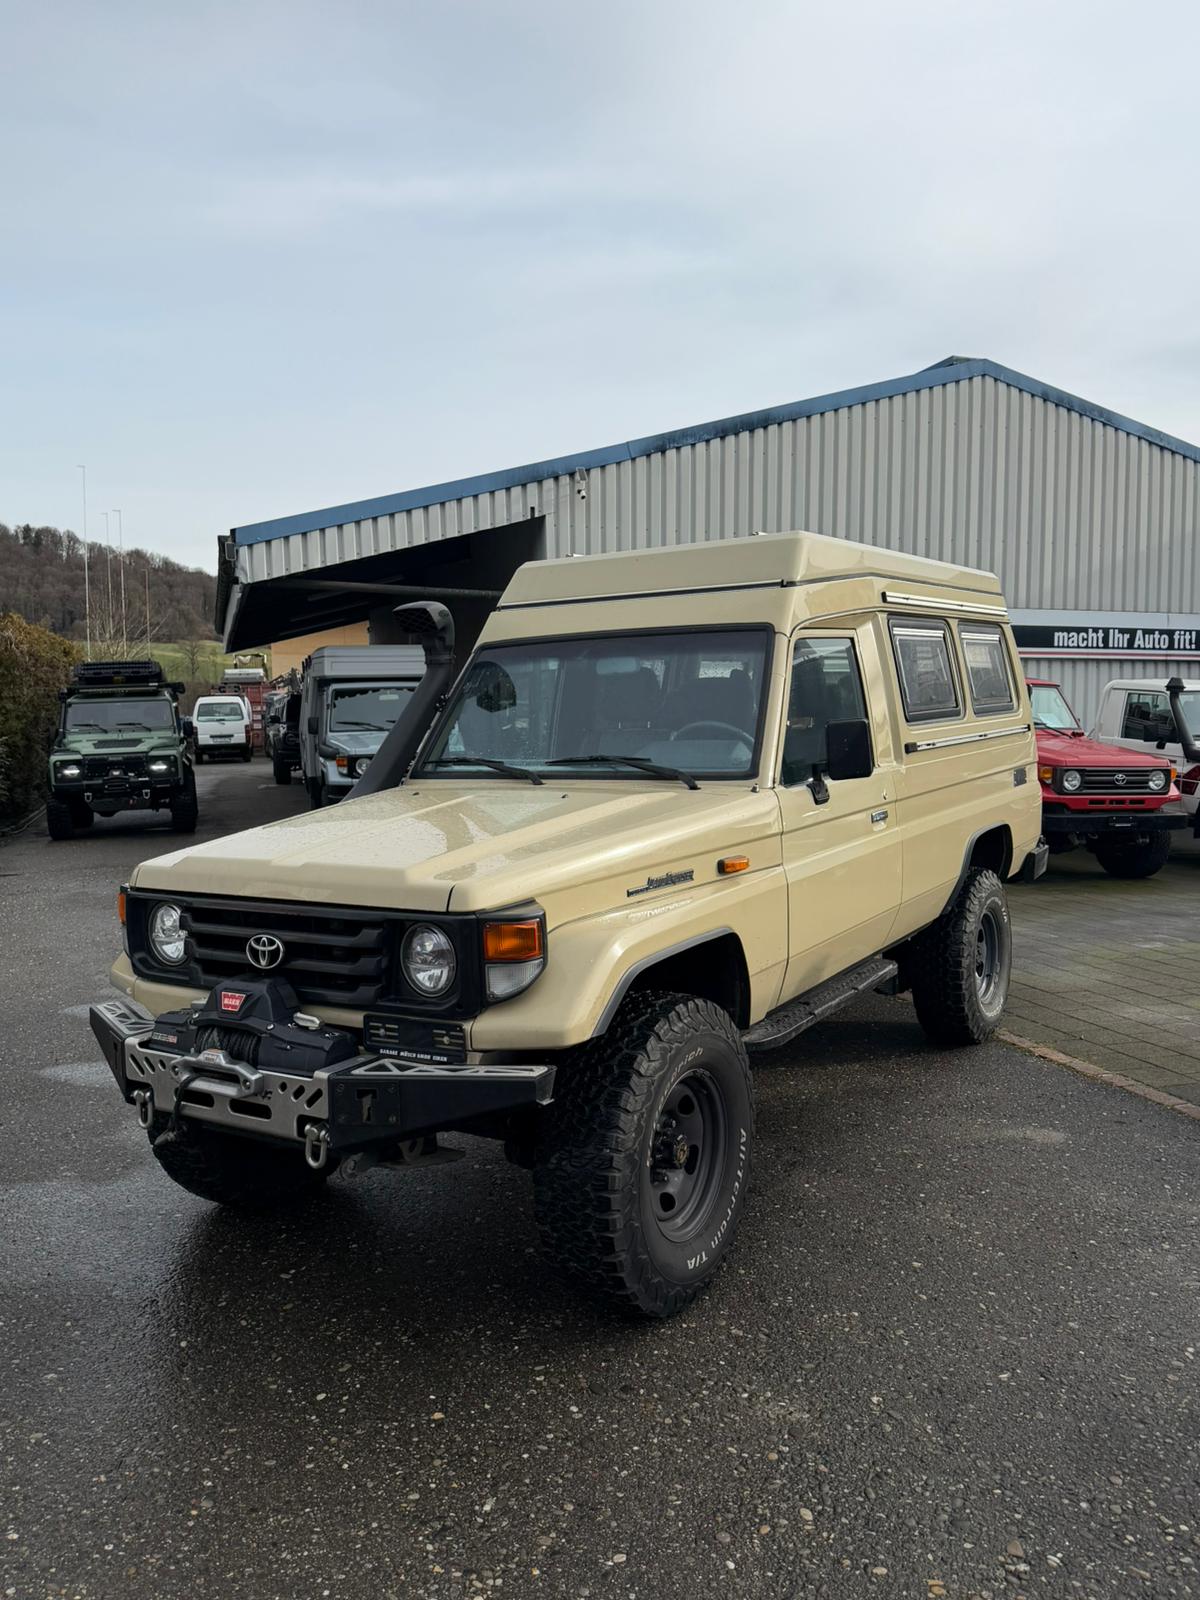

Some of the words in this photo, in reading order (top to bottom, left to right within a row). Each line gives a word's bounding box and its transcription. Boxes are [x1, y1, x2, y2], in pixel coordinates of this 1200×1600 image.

[1053, 628, 1104, 648] macht
[1108, 629, 1130, 648] Ihr
[1133, 629, 1169, 649] Auto
[1173, 630, 1196, 650] fit!
[687, 1250, 708, 1270] T/A
